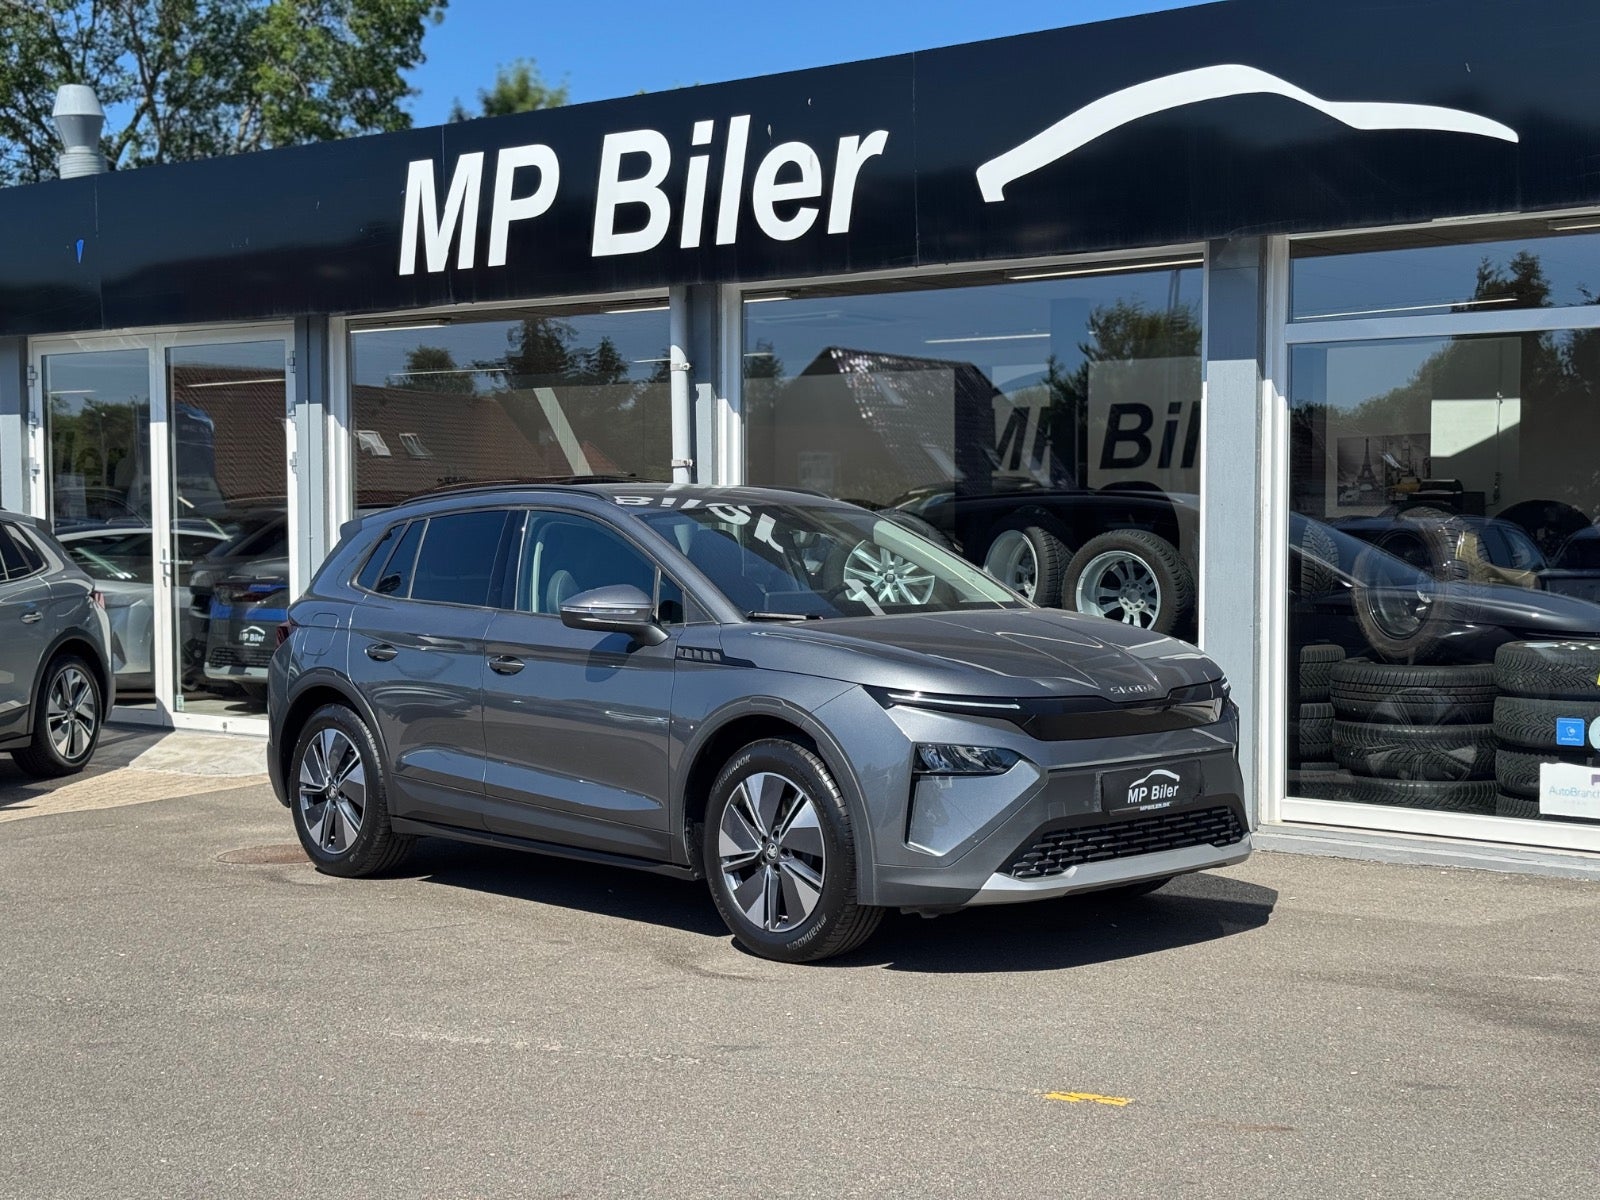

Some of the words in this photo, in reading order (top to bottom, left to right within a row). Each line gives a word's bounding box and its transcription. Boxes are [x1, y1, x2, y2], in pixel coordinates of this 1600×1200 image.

[398, 144, 560, 276] MP
[591, 114, 890, 257] Biler
[1127, 786, 1148, 804] MP
[1151, 783, 1180, 800] Biler
